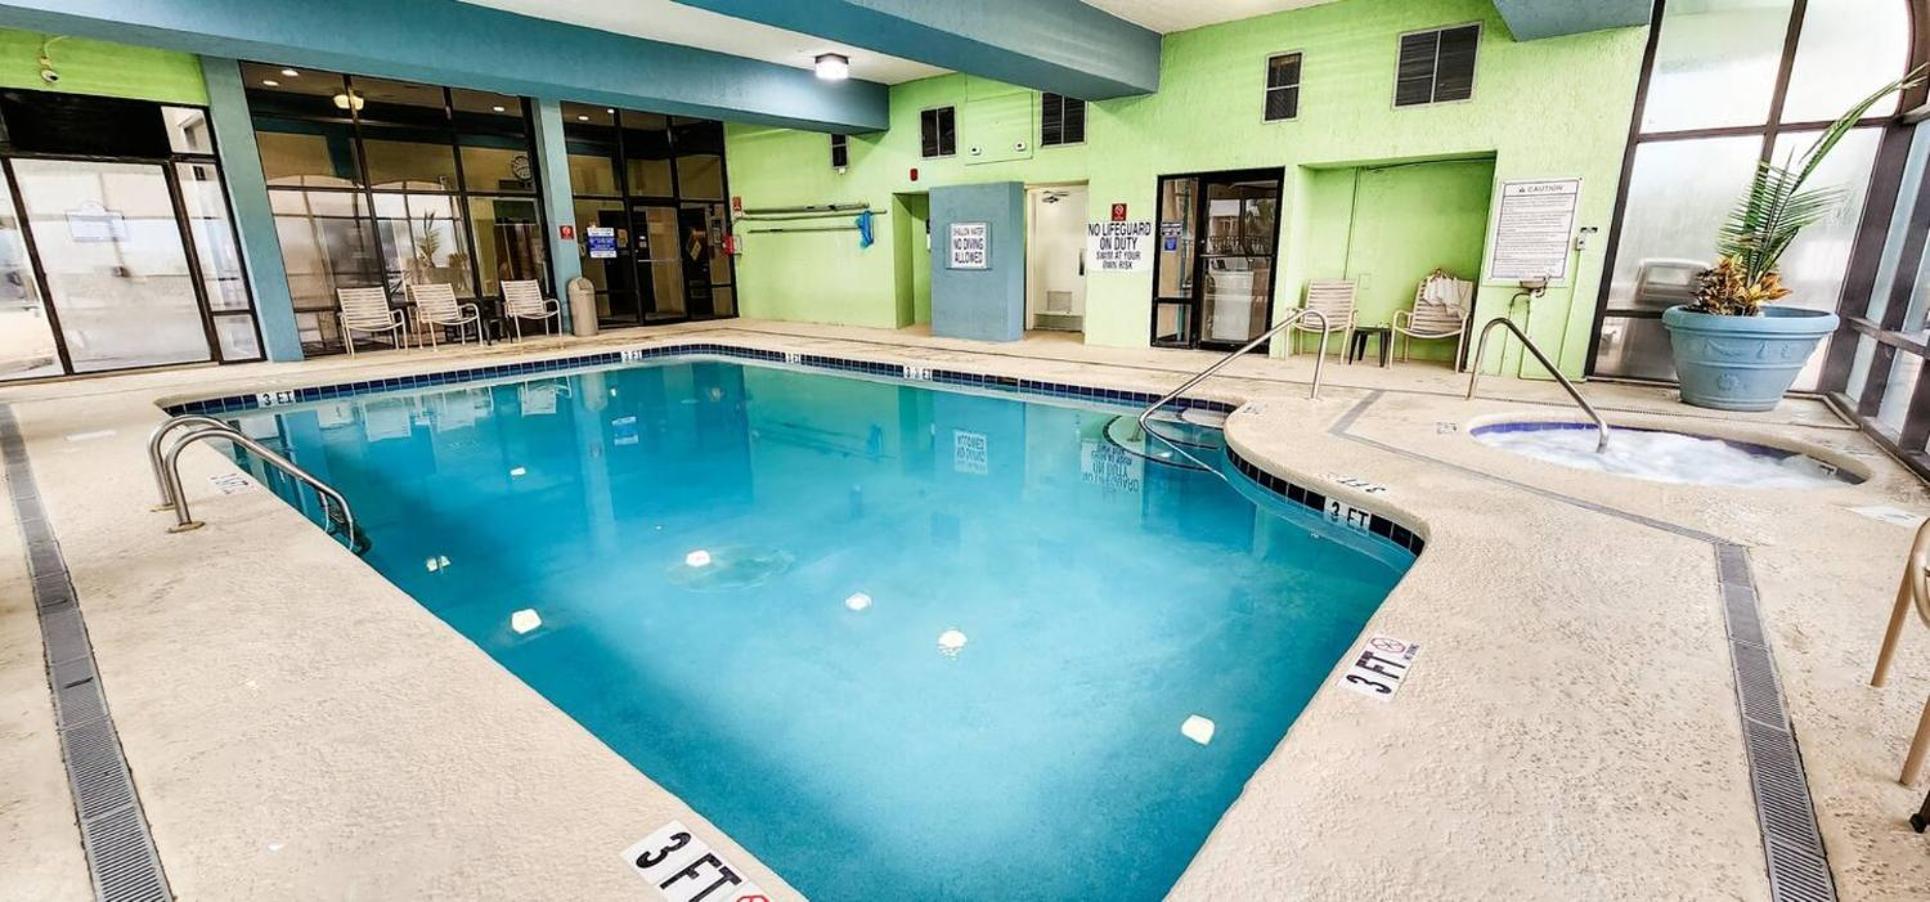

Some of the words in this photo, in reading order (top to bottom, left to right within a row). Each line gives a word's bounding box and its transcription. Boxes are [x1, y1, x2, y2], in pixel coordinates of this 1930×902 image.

[1088, 224, 1101, 236] NO
[1102, 222, 1151, 236] LIFEGUARD
[954, 238, 962, 250] NO
[963, 238, 984, 250] DIVING
[1100, 237, 1112, 250] ON
[1114, 237, 1137, 250] DUTY
[954, 251, 984, 264] ALLOWED
[1096, 252, 1113, 260] SWIM
[1115, 251, 1122, 260] AT
[1124, 251, 1140, 260] YOUR
[1103, 261, 1117, 270] OWN
[1119, 261, 1132, 270] RISK
[262, 393, 272, 406] 3
[1329, 501, 1340, 519] 3
[1346, 507, 1370, 527] FT
[1355, 650, 1406, 680] FT
[1346, 674, 1392, 694] 3
[635, 831, 692, 868] 3
[659, 852, 742, 902] FT
